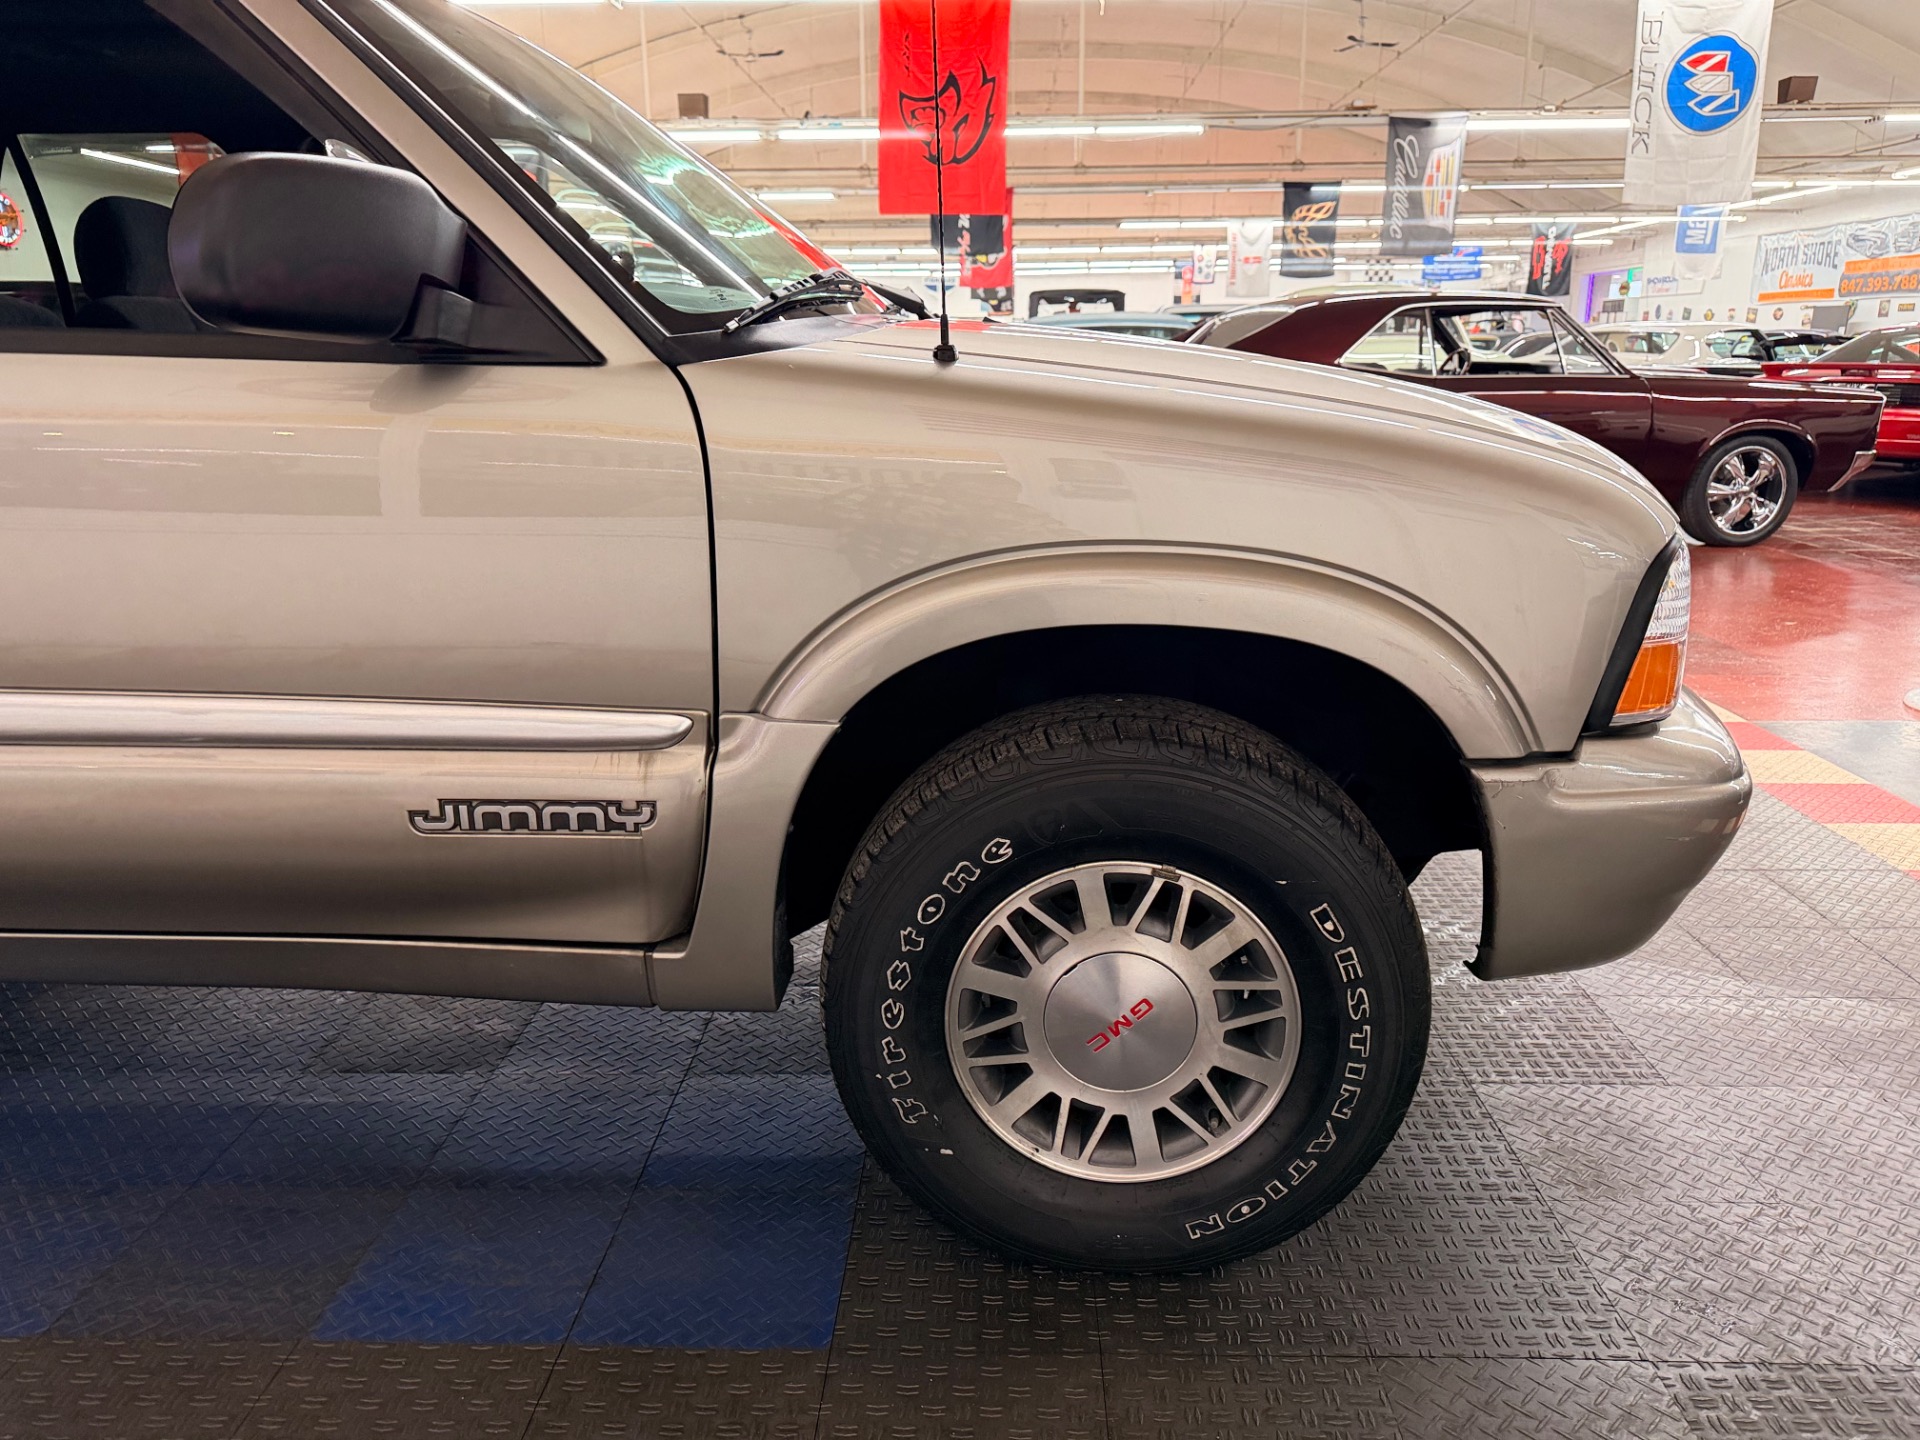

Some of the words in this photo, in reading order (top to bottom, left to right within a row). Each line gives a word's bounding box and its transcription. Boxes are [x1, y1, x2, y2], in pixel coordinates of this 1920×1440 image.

[1631, 11, 1664, 154] BUICK
[1390, 135, 1419, 239] Cadillac
[1761, 243, 1799, 276] NORTH
[1802, 239, 1841, 269] SHORE
[1086, 998, 1154, 1052] GMC
[1185, 903, 1371, 1239] DESTINATION
